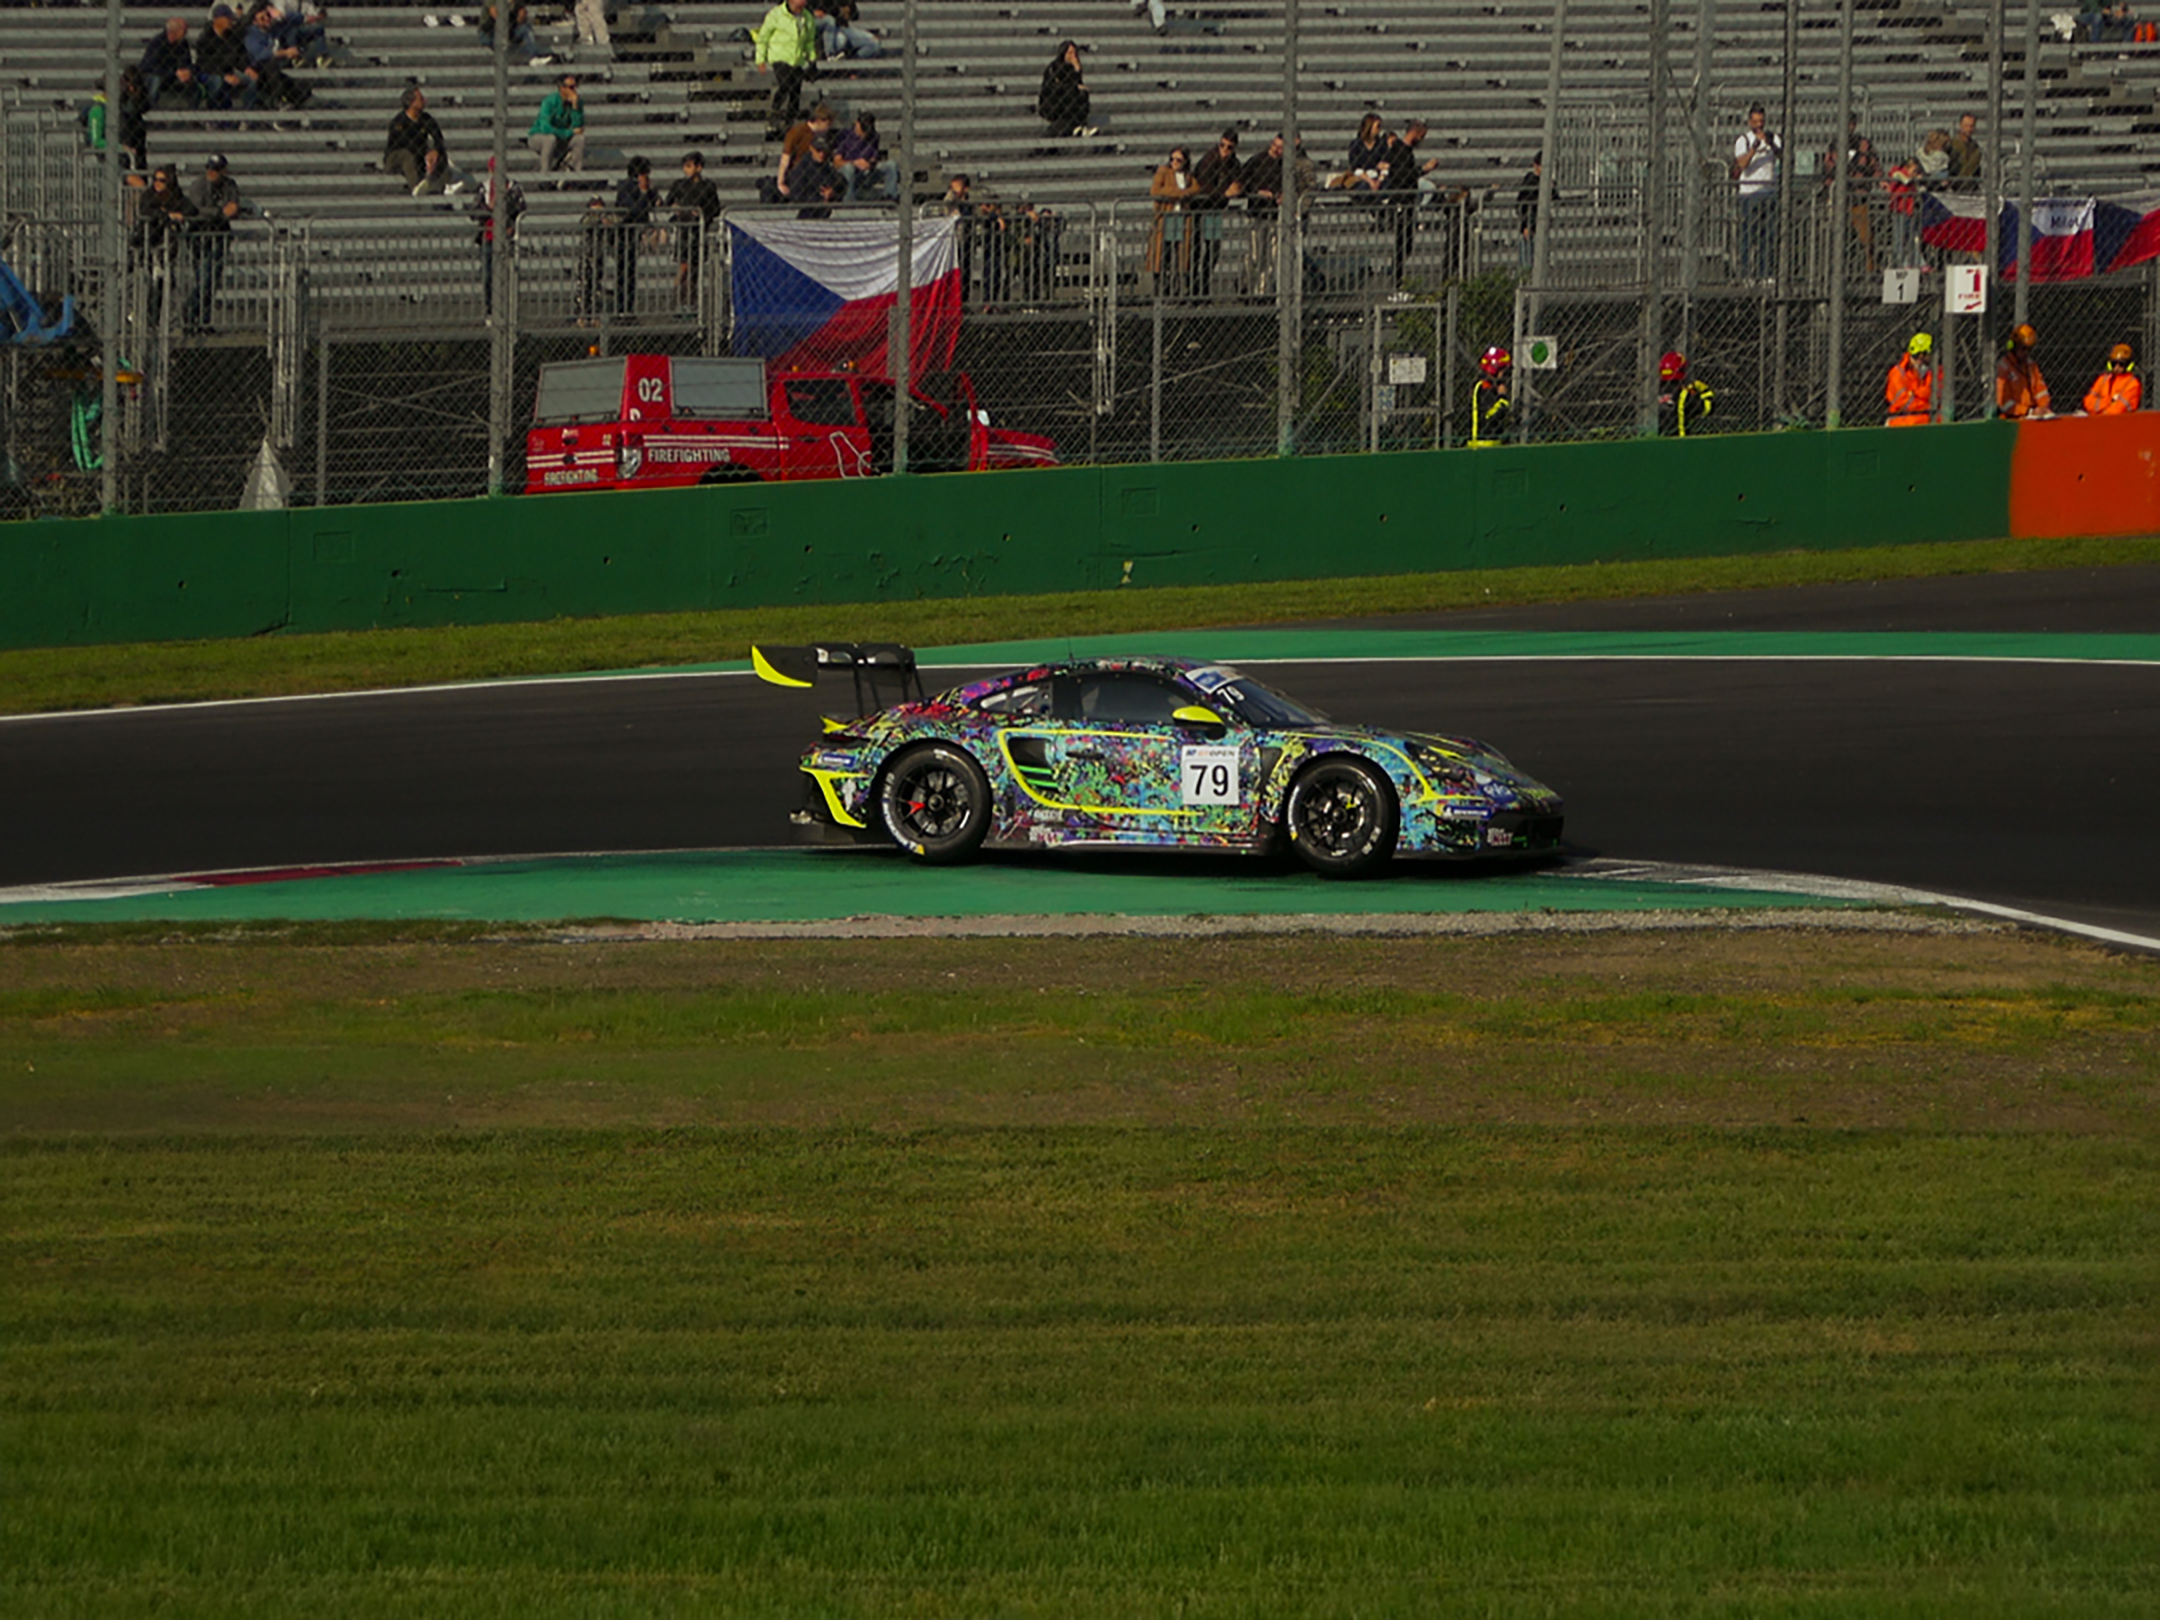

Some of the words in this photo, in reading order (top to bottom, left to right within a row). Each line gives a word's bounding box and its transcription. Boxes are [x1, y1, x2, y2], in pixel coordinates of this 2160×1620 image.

[1897, 283, 1904, 301] 1
[638, 377, 664, 402] 02
[647, 448, 731, 463] FIREFIGHTING
[1190, 765, 1228, 796] 79
